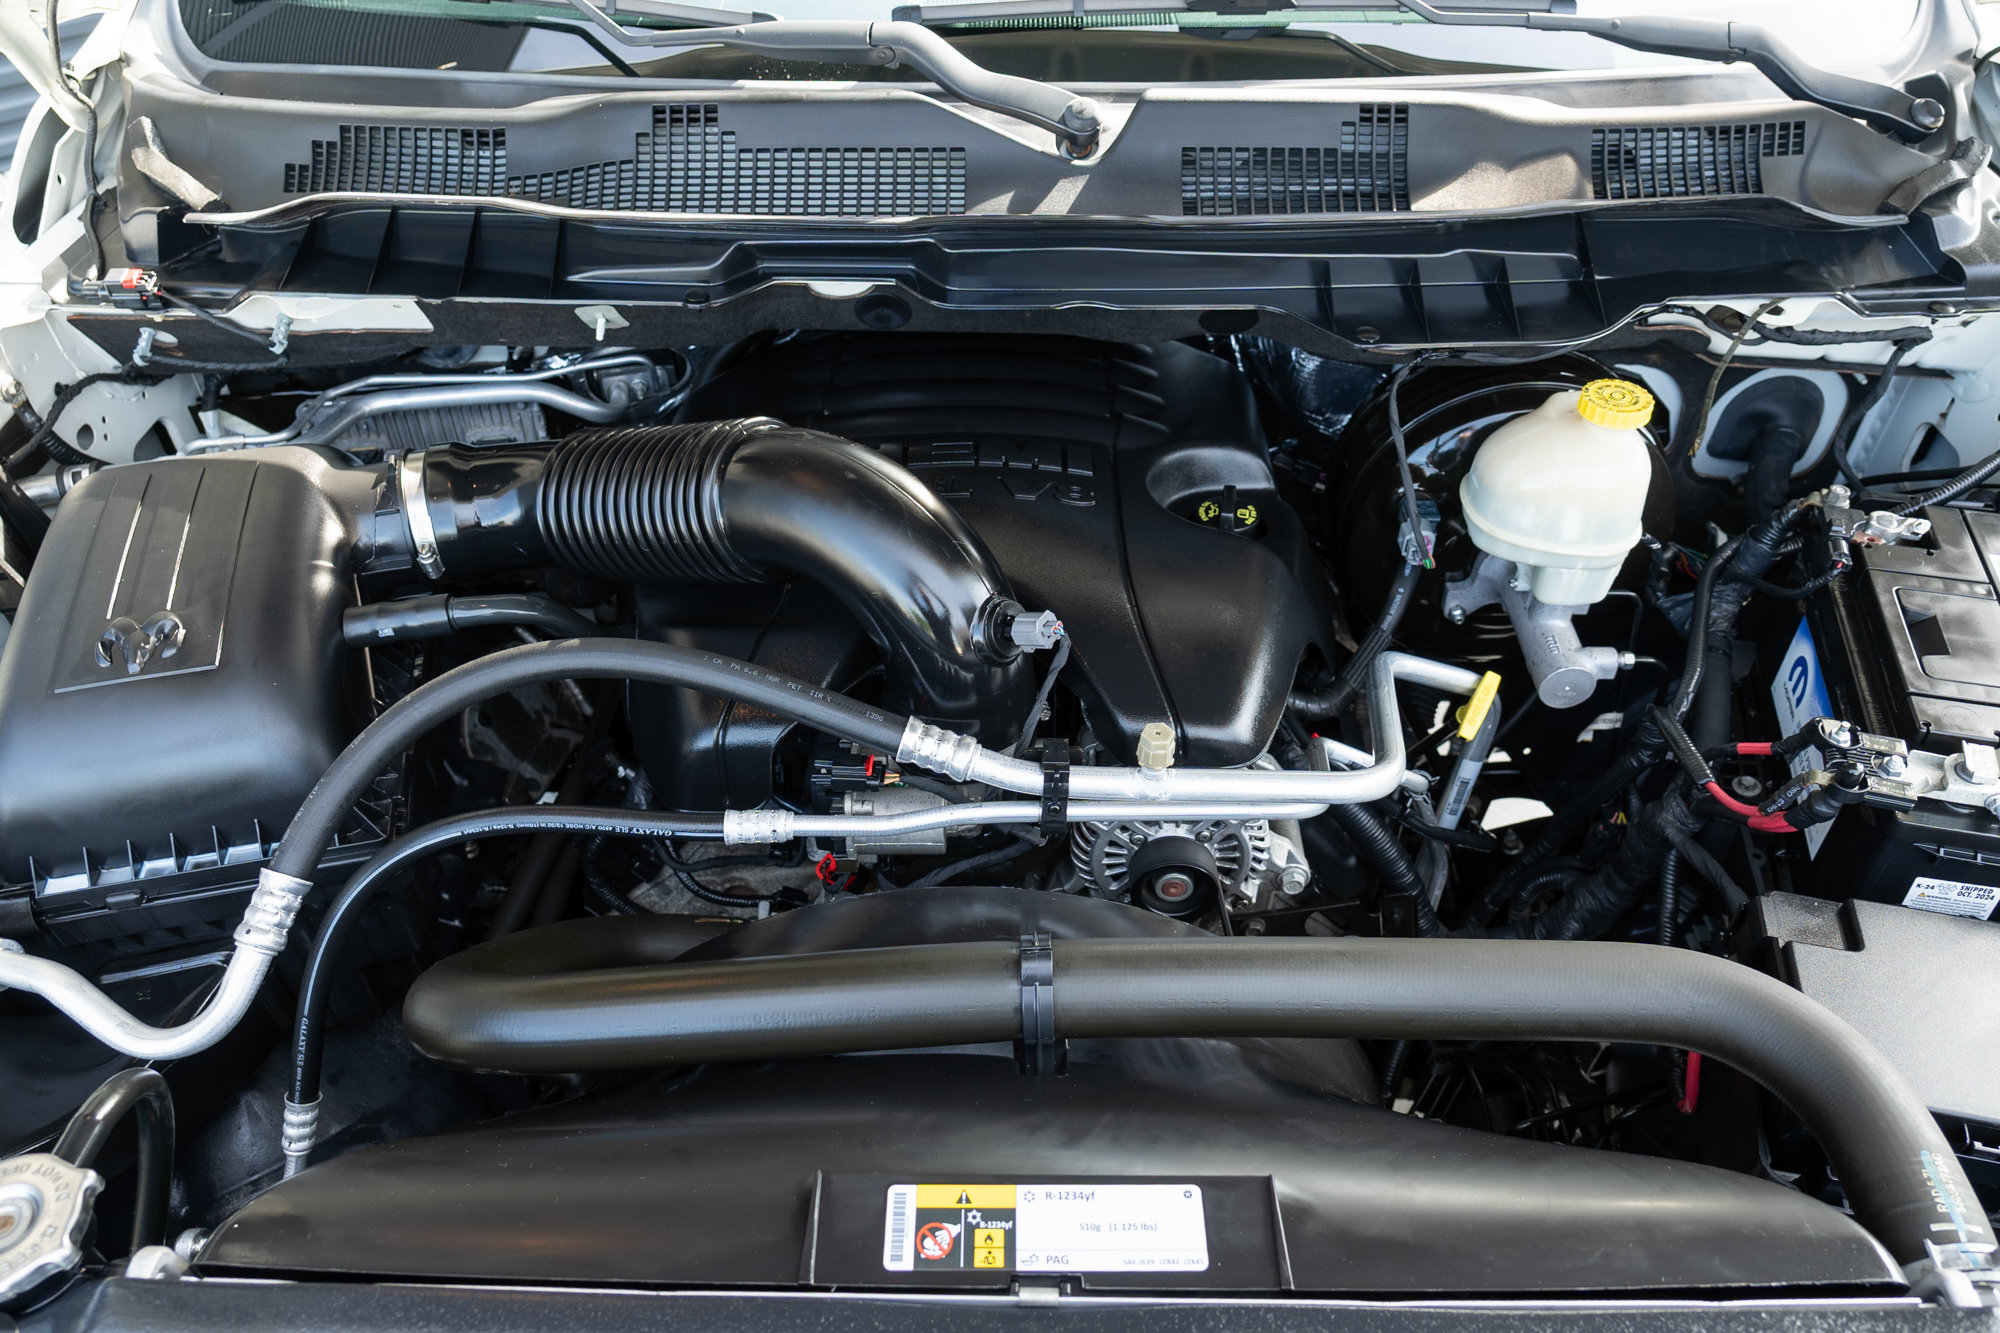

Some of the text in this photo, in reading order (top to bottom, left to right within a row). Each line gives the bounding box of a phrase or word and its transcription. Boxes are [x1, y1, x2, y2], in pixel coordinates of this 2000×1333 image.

[743, 666, 758, 676] 6.6
[787, 681, 802, 691] PET
[865, 711, 885, 722] 1396
[463, 825, 489, 835] R-1234yf
[615, 825, 629, 833] SLE
[630, 827, 672, 837] GALAXY
[1960, 885, 1994, 895] SHIPPED
[1957, 891, 1996, 901] OCT. 2024
[298, 1017, 309, 1054] GALAXY
[296, 1053, 305, 1066] SLE
[0, 1162, 70, 1202] DO NOT OPE
[1045, 1190, 1096, 1203] R-1234yf
[1931, 1188, 1950, 1213] RAD
[979, 1220, 1014, 1231] R-1234yf
[1079, 1222, 1158, 1233] 510g (1.125 lbs)
[1046, 1255, 1070, 1265] PAG
